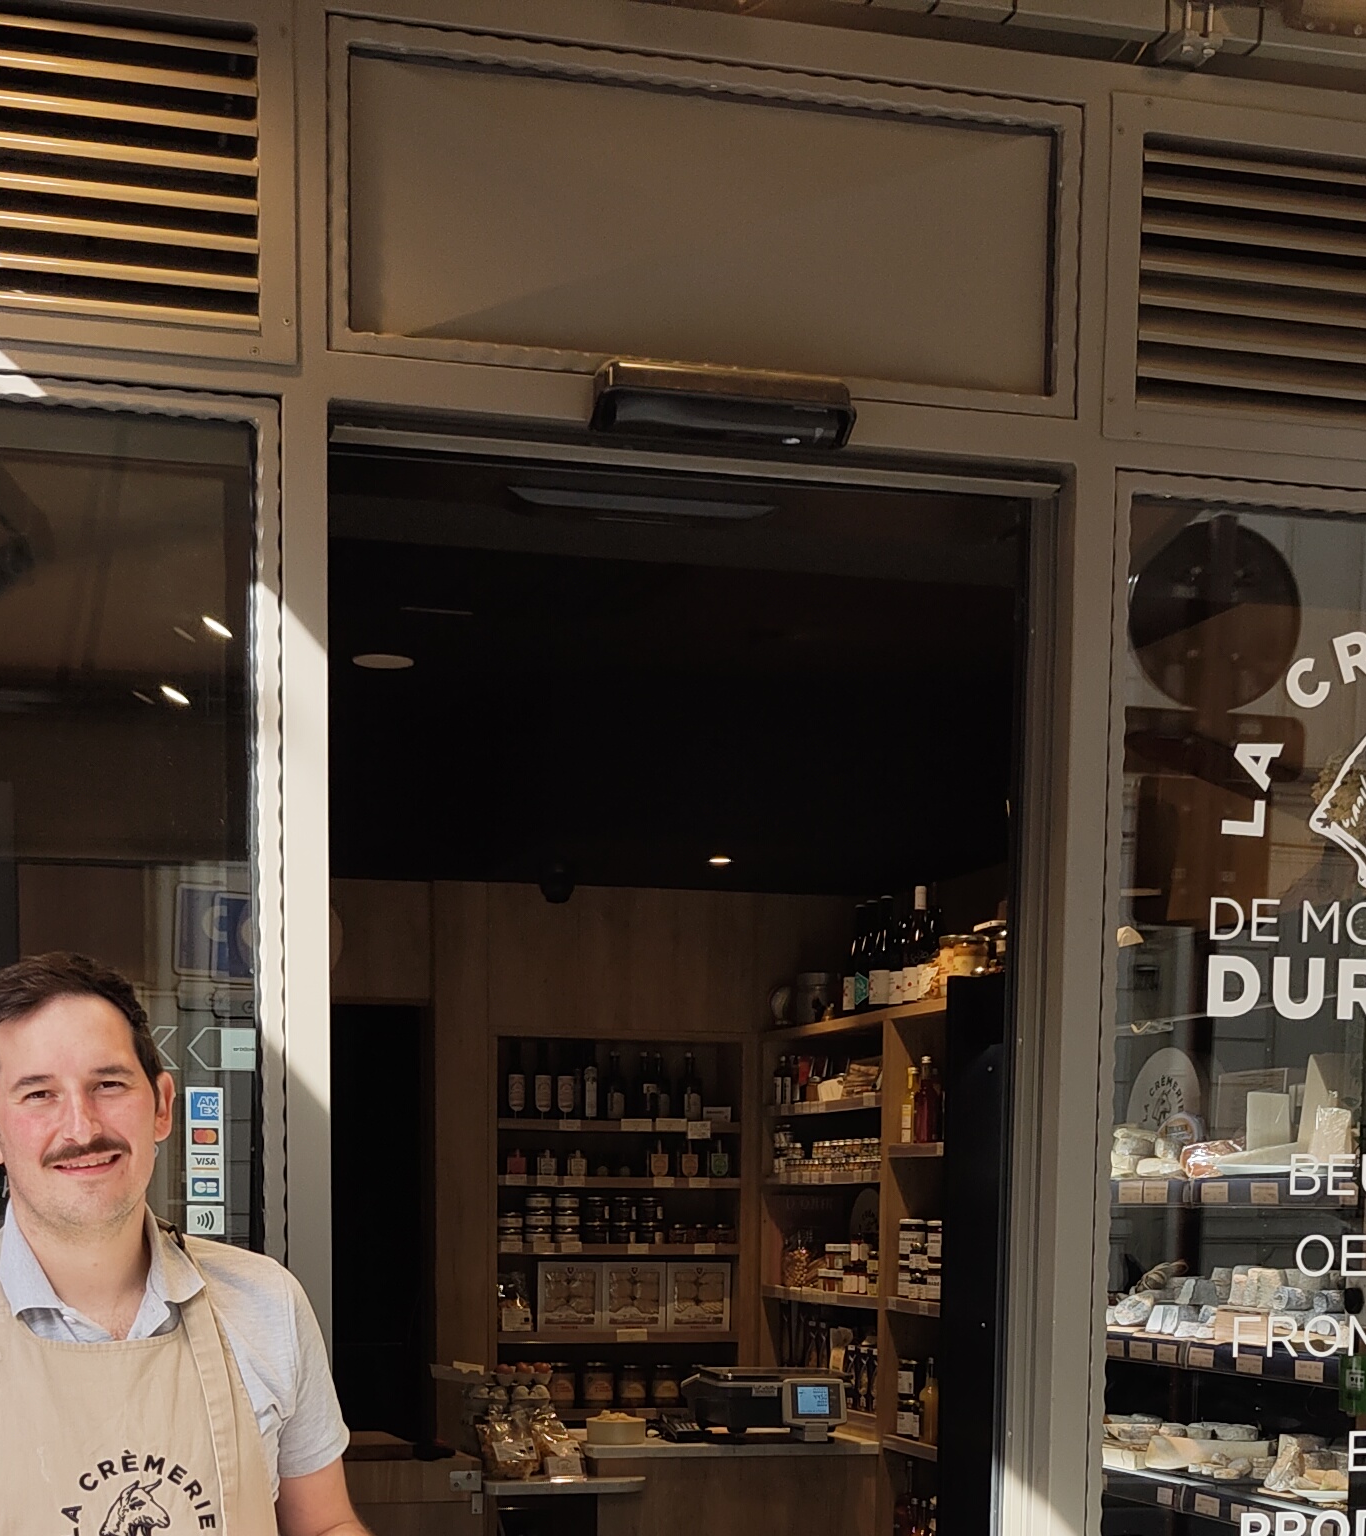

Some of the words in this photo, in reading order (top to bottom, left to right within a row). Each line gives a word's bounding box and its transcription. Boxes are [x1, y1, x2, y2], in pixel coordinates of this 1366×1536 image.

[1221, 741, 1284, 837] LA
[1208, 896, 1280, 943] DE
[195, 1156, 217, 1166] VISA
[193, 1181, 218, 1194] CB
[78, 1449, 217, 1532] CRÈMERIE
